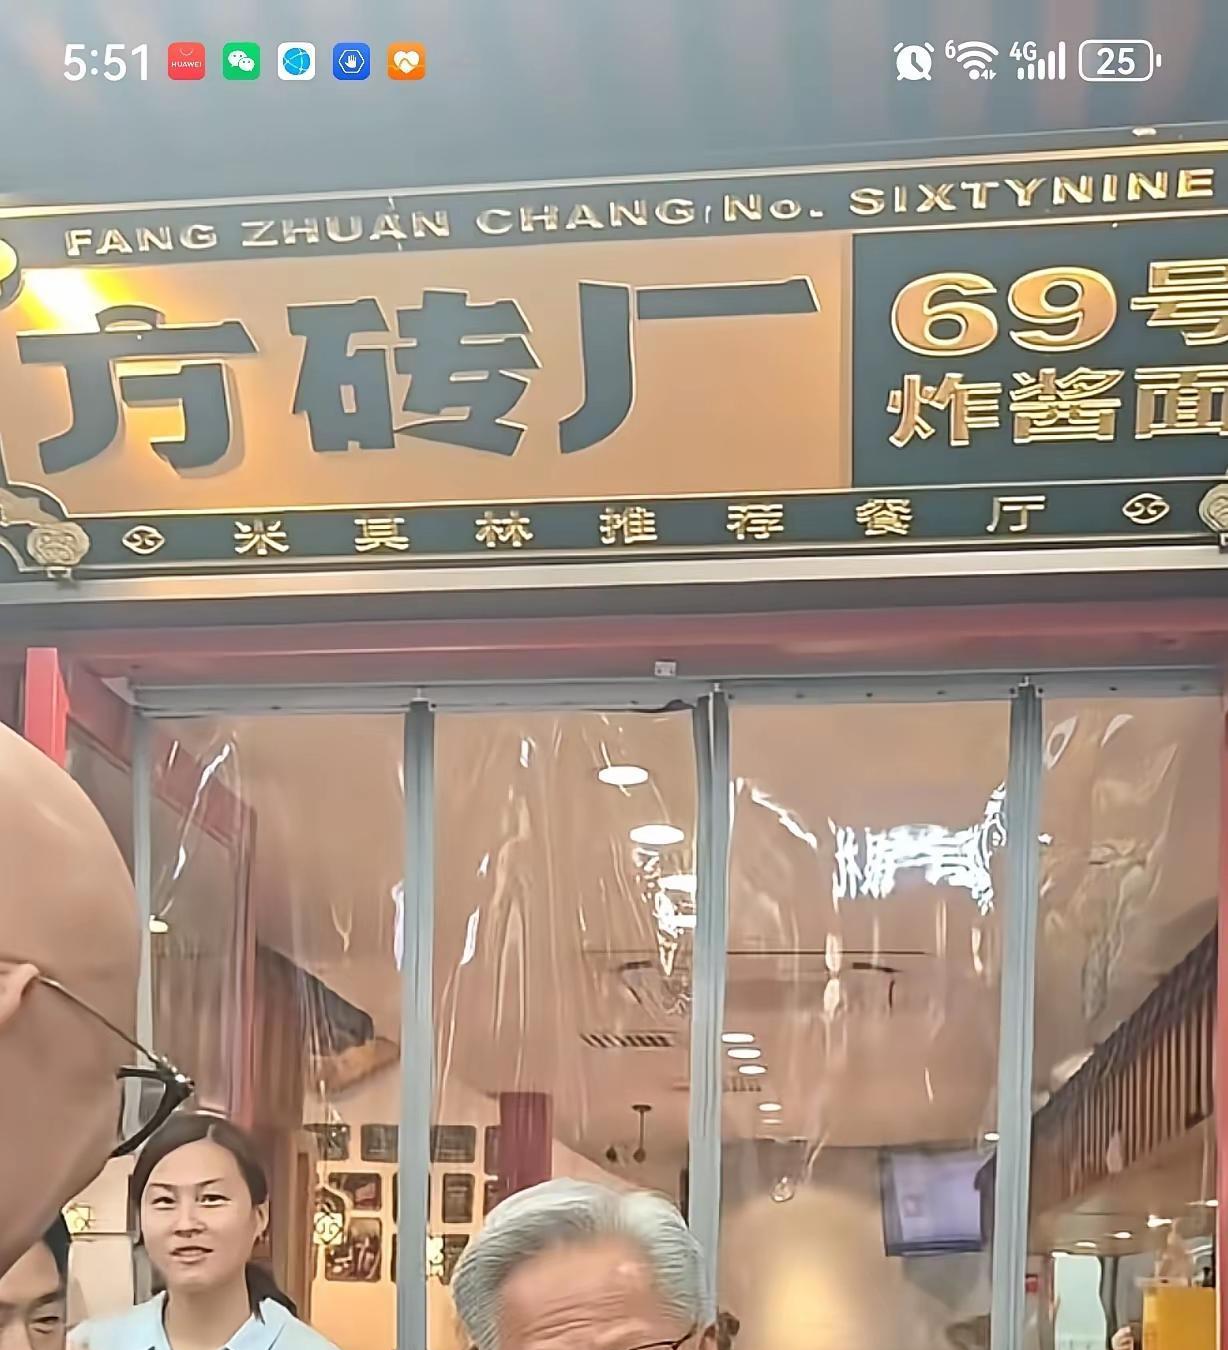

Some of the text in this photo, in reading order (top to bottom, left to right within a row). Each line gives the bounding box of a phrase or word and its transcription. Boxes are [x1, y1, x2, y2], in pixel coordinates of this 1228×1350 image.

[64, 168, 1215, 258] FANG ZHUAN CHANG No. SIXTYNINE
[890, 258, 1228, 357] 69号
[16, 275, 821, 477] 方砖厂
[887, 363, 1228, 448] 炸酱面
[233, 494, 1046, 556] 米其林推荐餐厅
